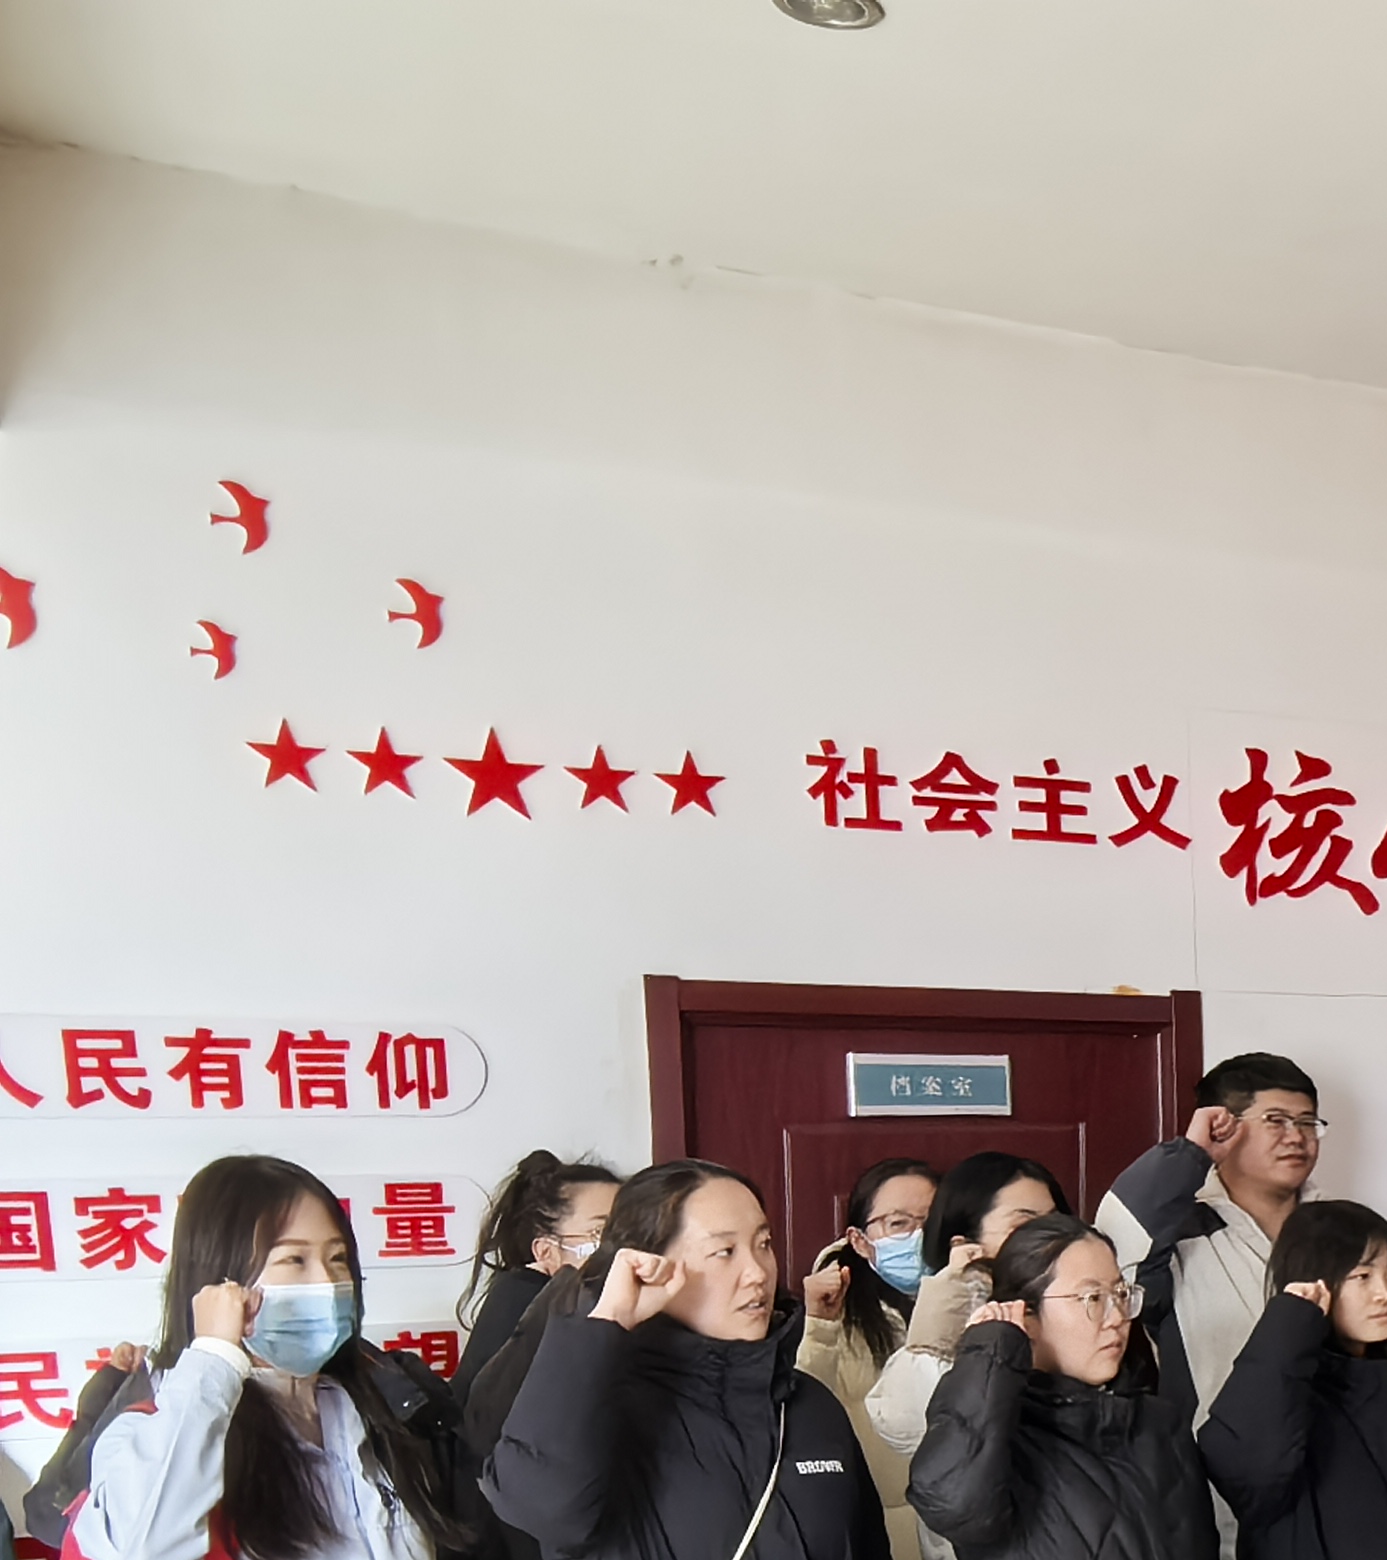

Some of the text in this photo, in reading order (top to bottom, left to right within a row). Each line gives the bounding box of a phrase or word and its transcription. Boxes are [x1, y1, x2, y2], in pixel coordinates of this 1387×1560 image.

[890, 1074, 973, 1097] 档案室
[0, 1182, 456, 1272] 国家量
